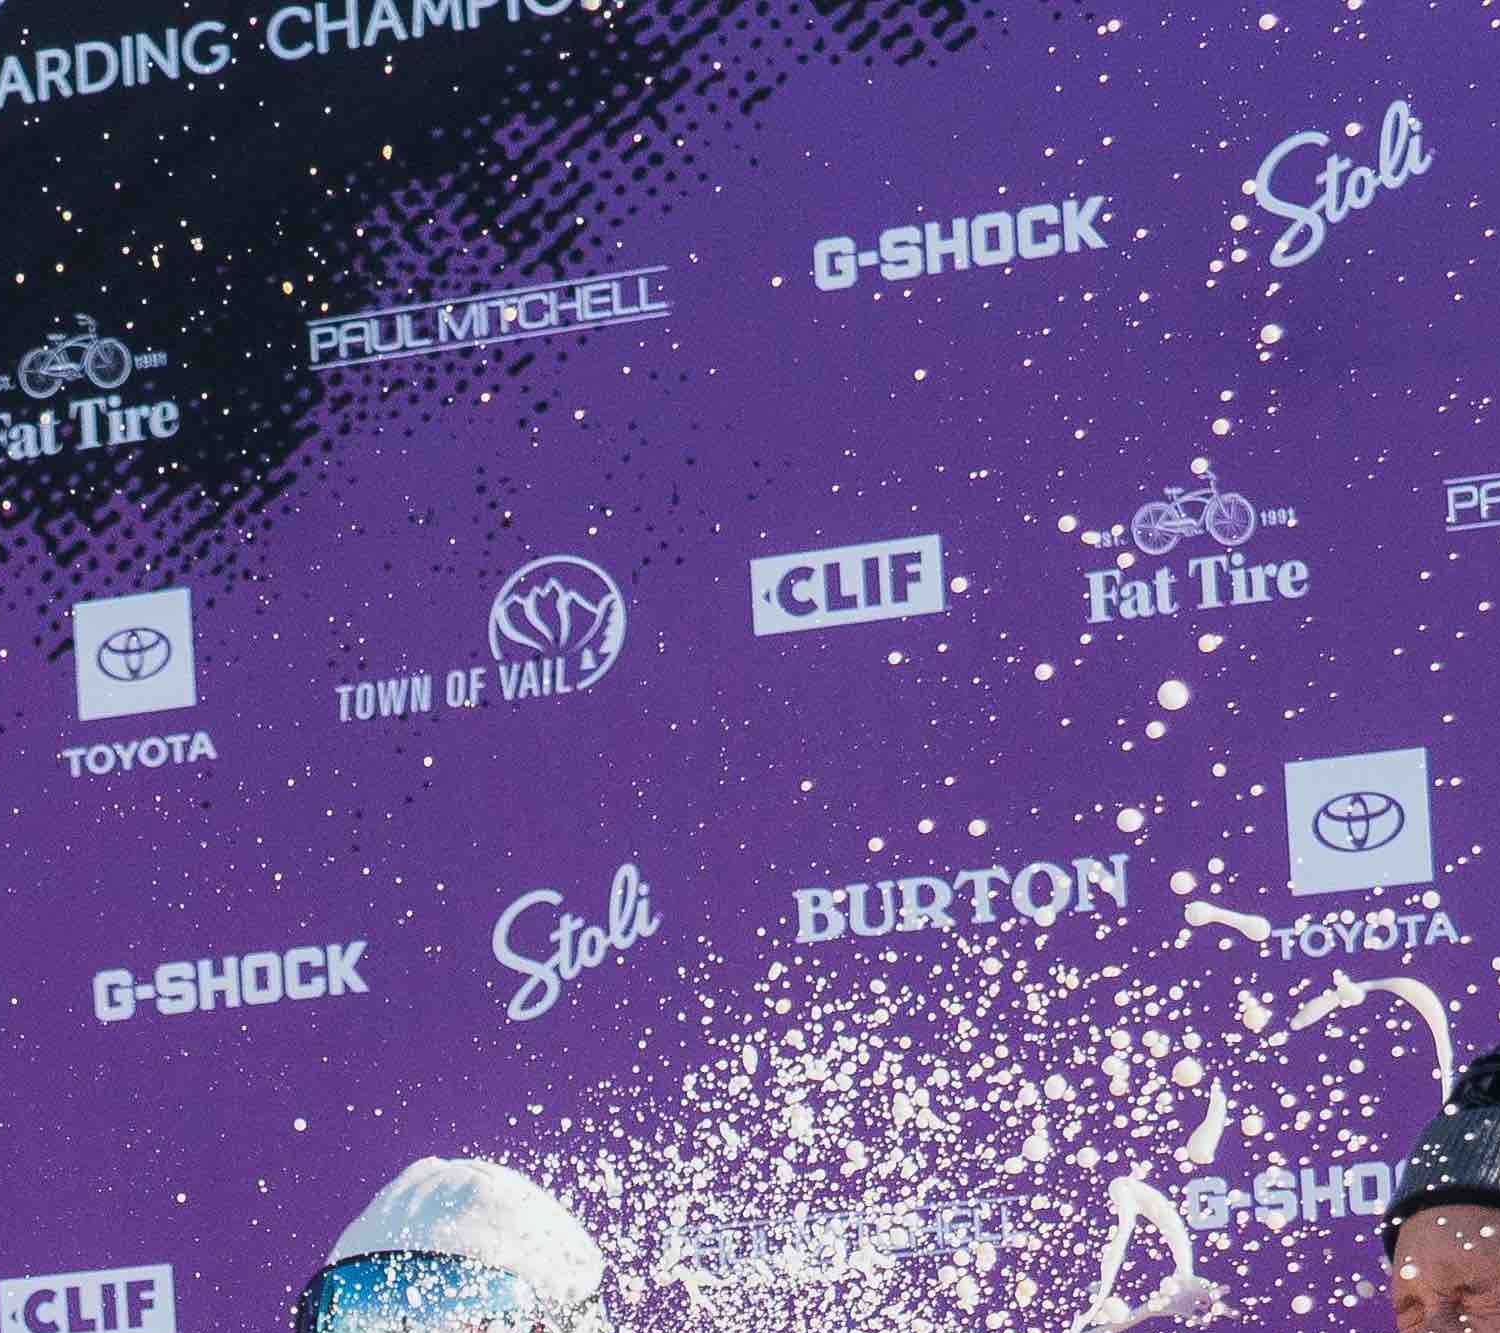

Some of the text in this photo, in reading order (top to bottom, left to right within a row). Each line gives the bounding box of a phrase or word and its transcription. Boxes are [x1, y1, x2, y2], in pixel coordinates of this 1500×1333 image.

[1250, 99, 1433, 268] Stoli
[813, 195, 1113, 291] G-SHOCK
[307, 281, 667, 372] PAUL MITCHELL
[69, 397, 179, 450] Tire
[776, 550, 922, 617] CLIF
[1084, 554, 1309, 624] Fat Tire
[334, 656, 573, 723] TOWN OF VAIL
[61, 731, 217, 778] TOYOTA
[794, 852, 1130, 945] BURTON
[492, 863, 660, 1021] Stoli
[1270, 910, 1460, 963] TOYOTA
[92, 940, 369, 1026] G-SHOCK
[1186, 1160, 1402, 1232] G-SHO
